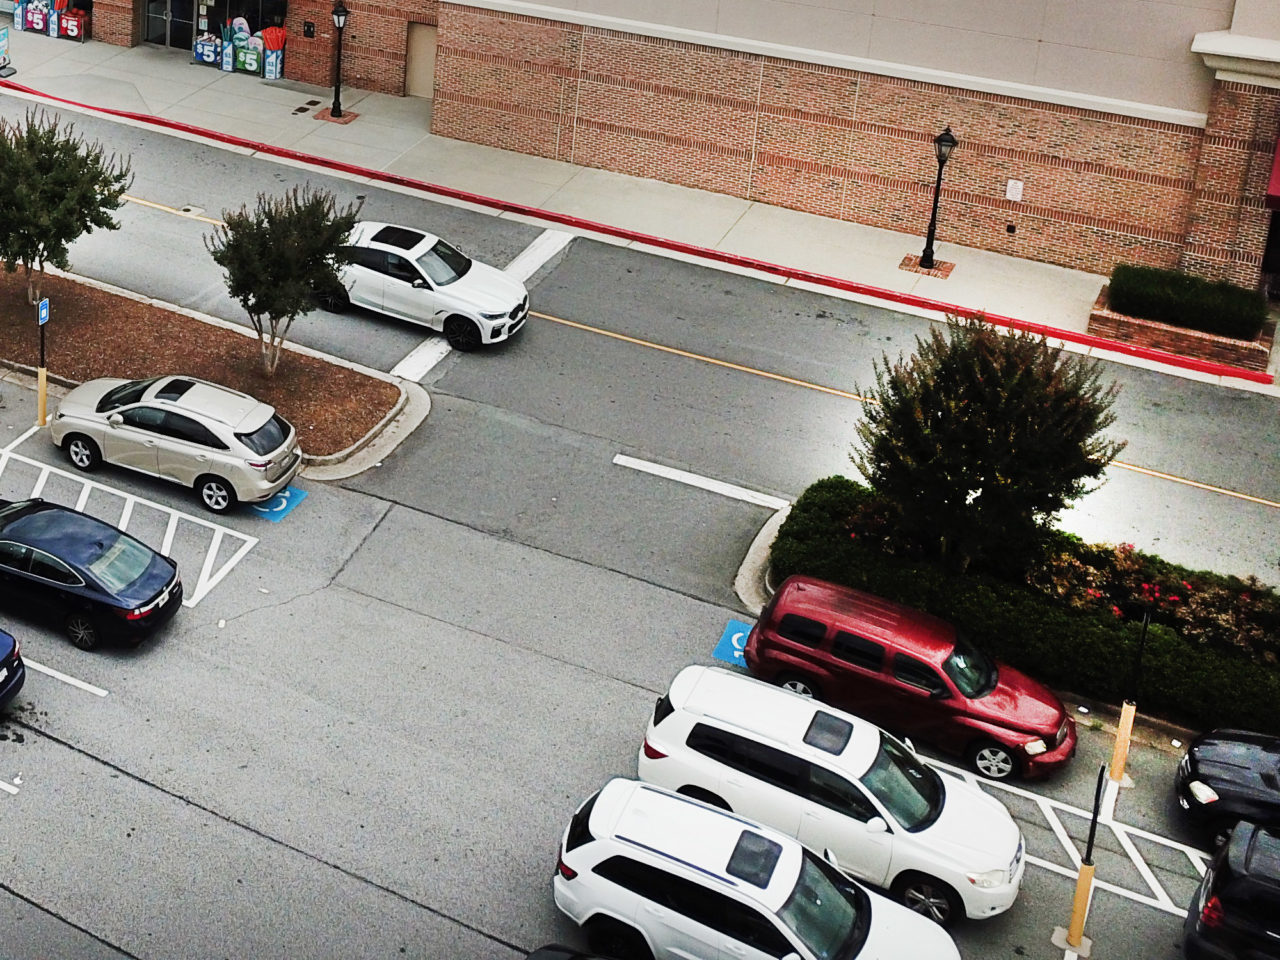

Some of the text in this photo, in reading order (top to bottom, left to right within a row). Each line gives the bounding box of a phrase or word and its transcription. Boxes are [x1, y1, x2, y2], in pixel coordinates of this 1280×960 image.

[27, 12, 44, 30] $5
[61, 18, 79, 37] $5
[196, 43, 215, 63] $5
[238, 51, 258, 71] $5
